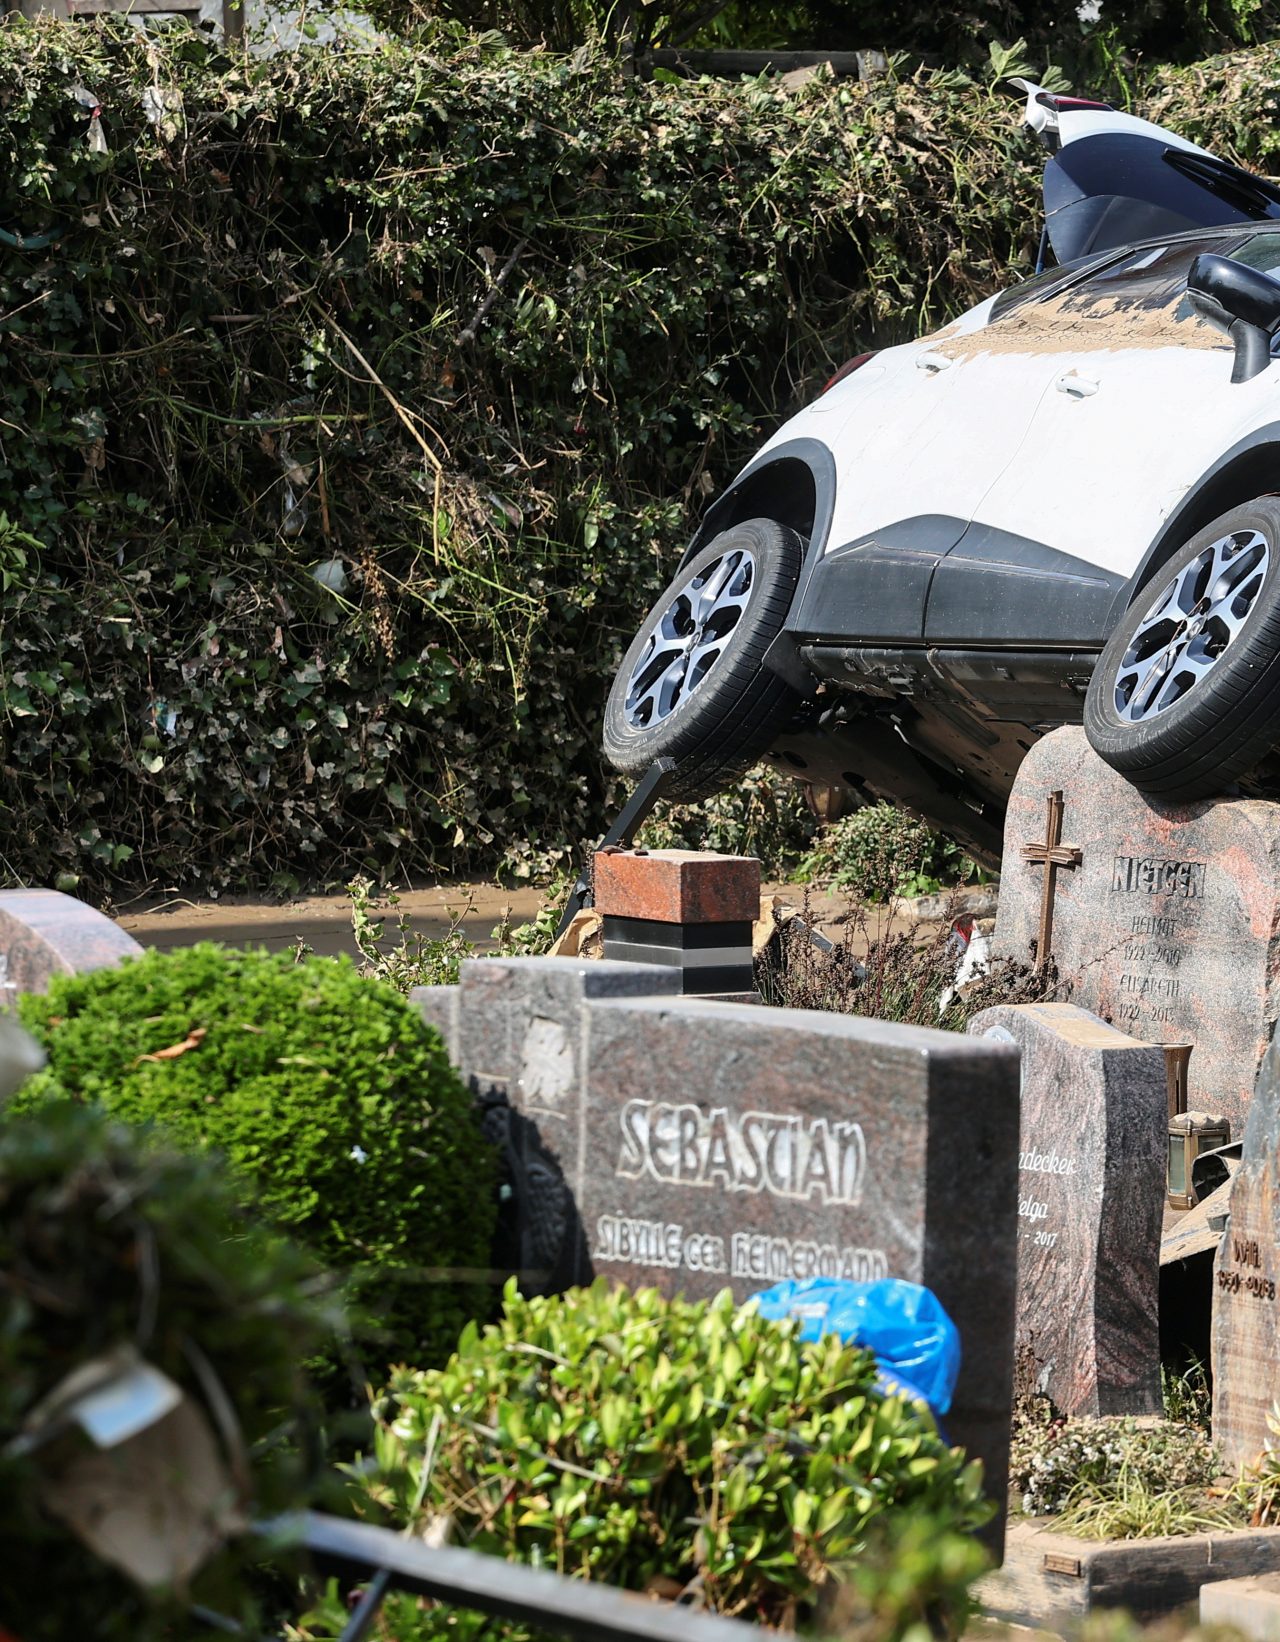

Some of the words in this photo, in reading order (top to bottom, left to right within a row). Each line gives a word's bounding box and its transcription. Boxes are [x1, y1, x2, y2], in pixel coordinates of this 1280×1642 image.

[615, 1098, 867, 1206] SEBASTIAN
[1017, 1192, 1049, 1223] elga
[1034, 1230, 1058, 1248] 2017
